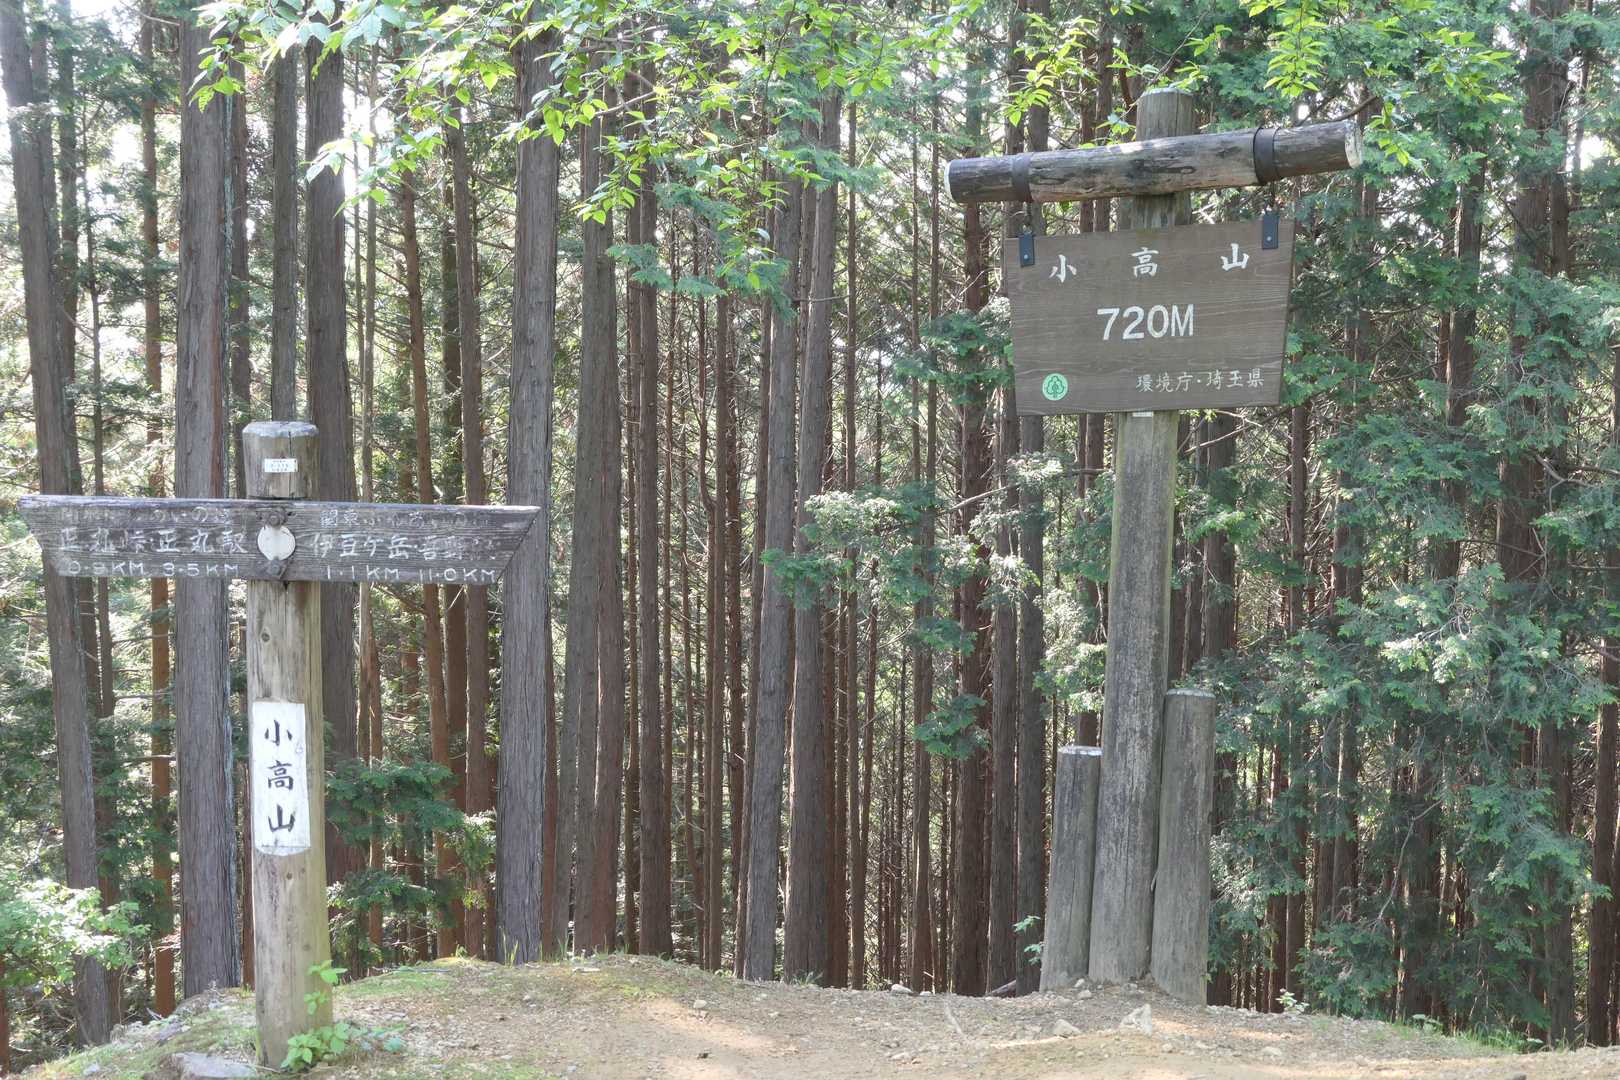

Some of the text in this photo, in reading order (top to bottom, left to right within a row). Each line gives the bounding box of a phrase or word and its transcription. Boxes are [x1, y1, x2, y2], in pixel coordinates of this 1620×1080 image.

[1097, 303, 1194, 341] 720M
[1136, 368, 1265, 393] 環境庁・埼玉県
[264, 719, 296, 833] 小高山
